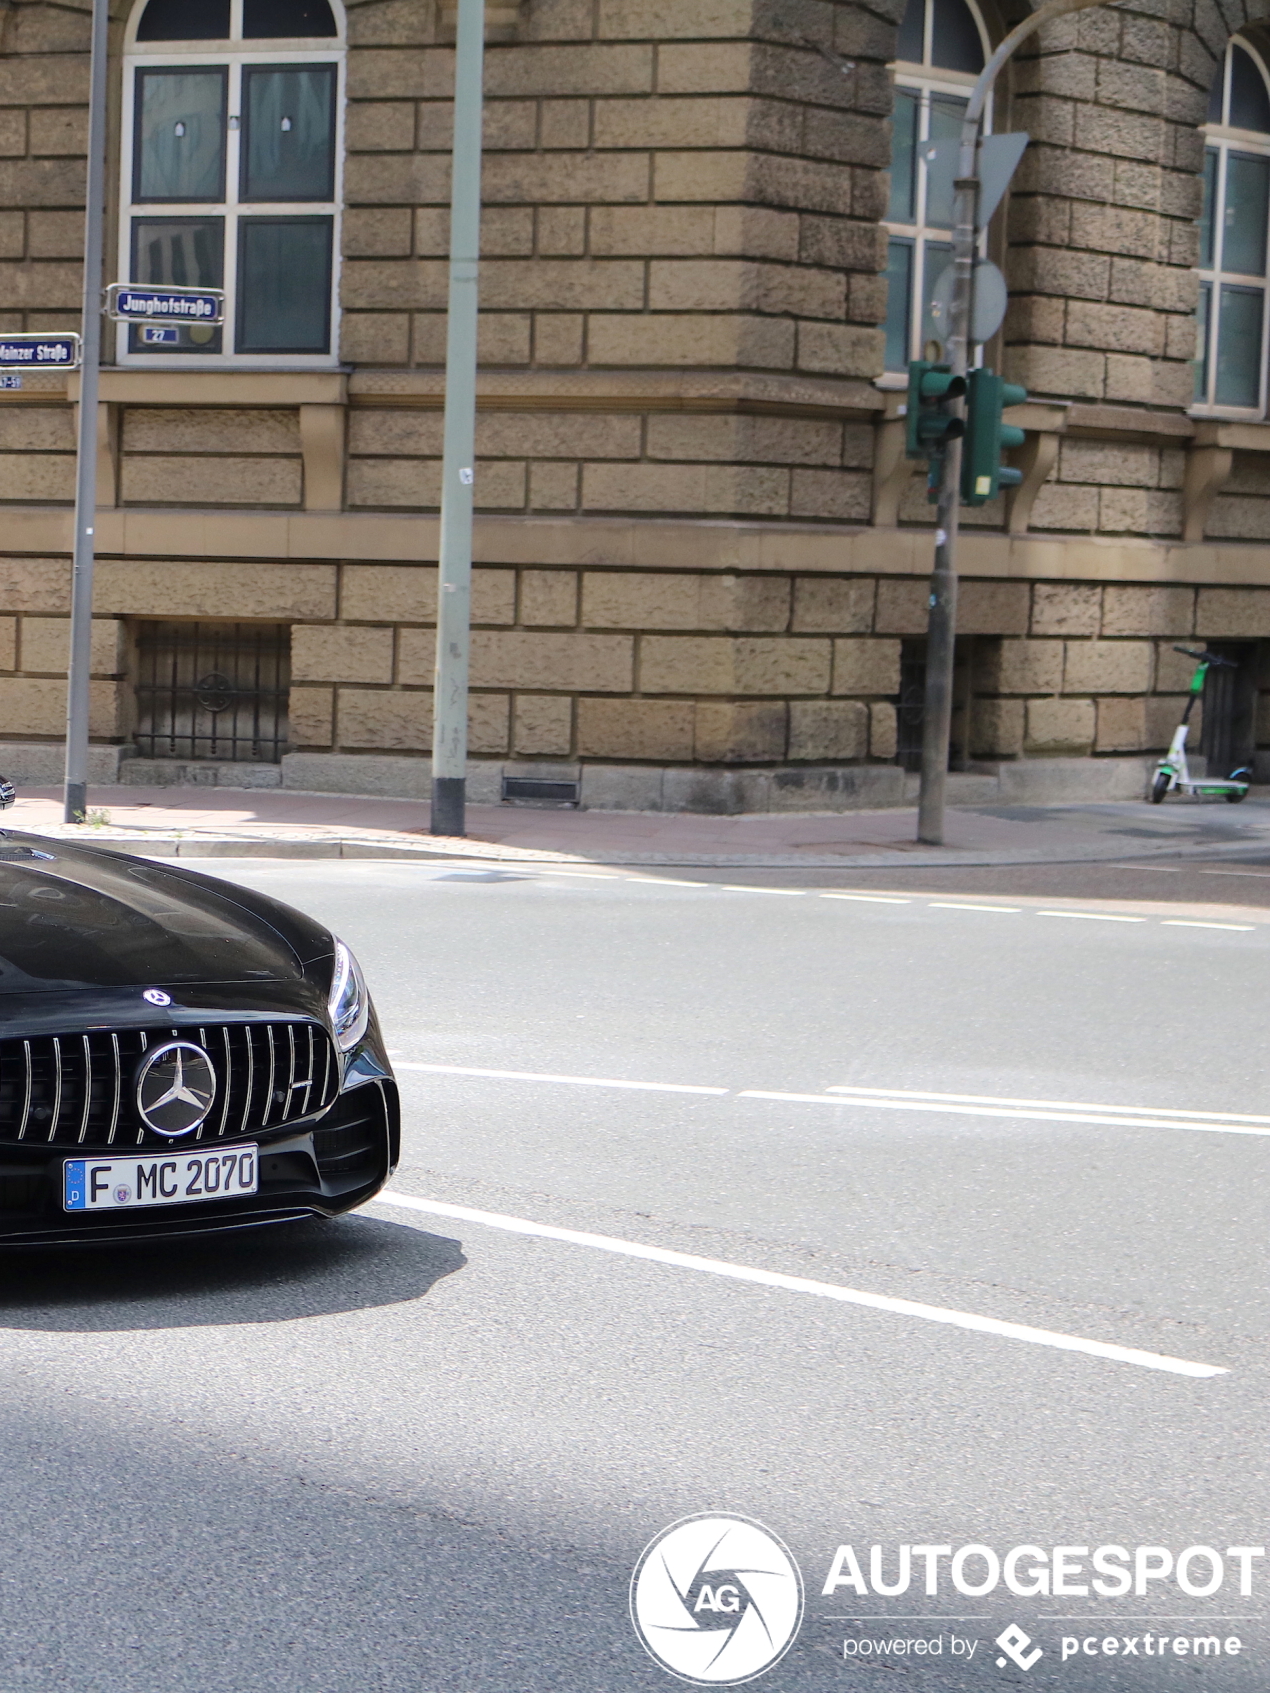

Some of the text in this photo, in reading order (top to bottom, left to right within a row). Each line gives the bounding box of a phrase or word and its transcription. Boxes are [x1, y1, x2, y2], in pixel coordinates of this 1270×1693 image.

[123, 294, 212, 317] Junghofstraße
[151, 329, 165, 341] 27
[36, 343, 68, 362] Straße
[90, 1153, 254, 1203] F MC 2070
[71, 1190, 80, 1202] D
